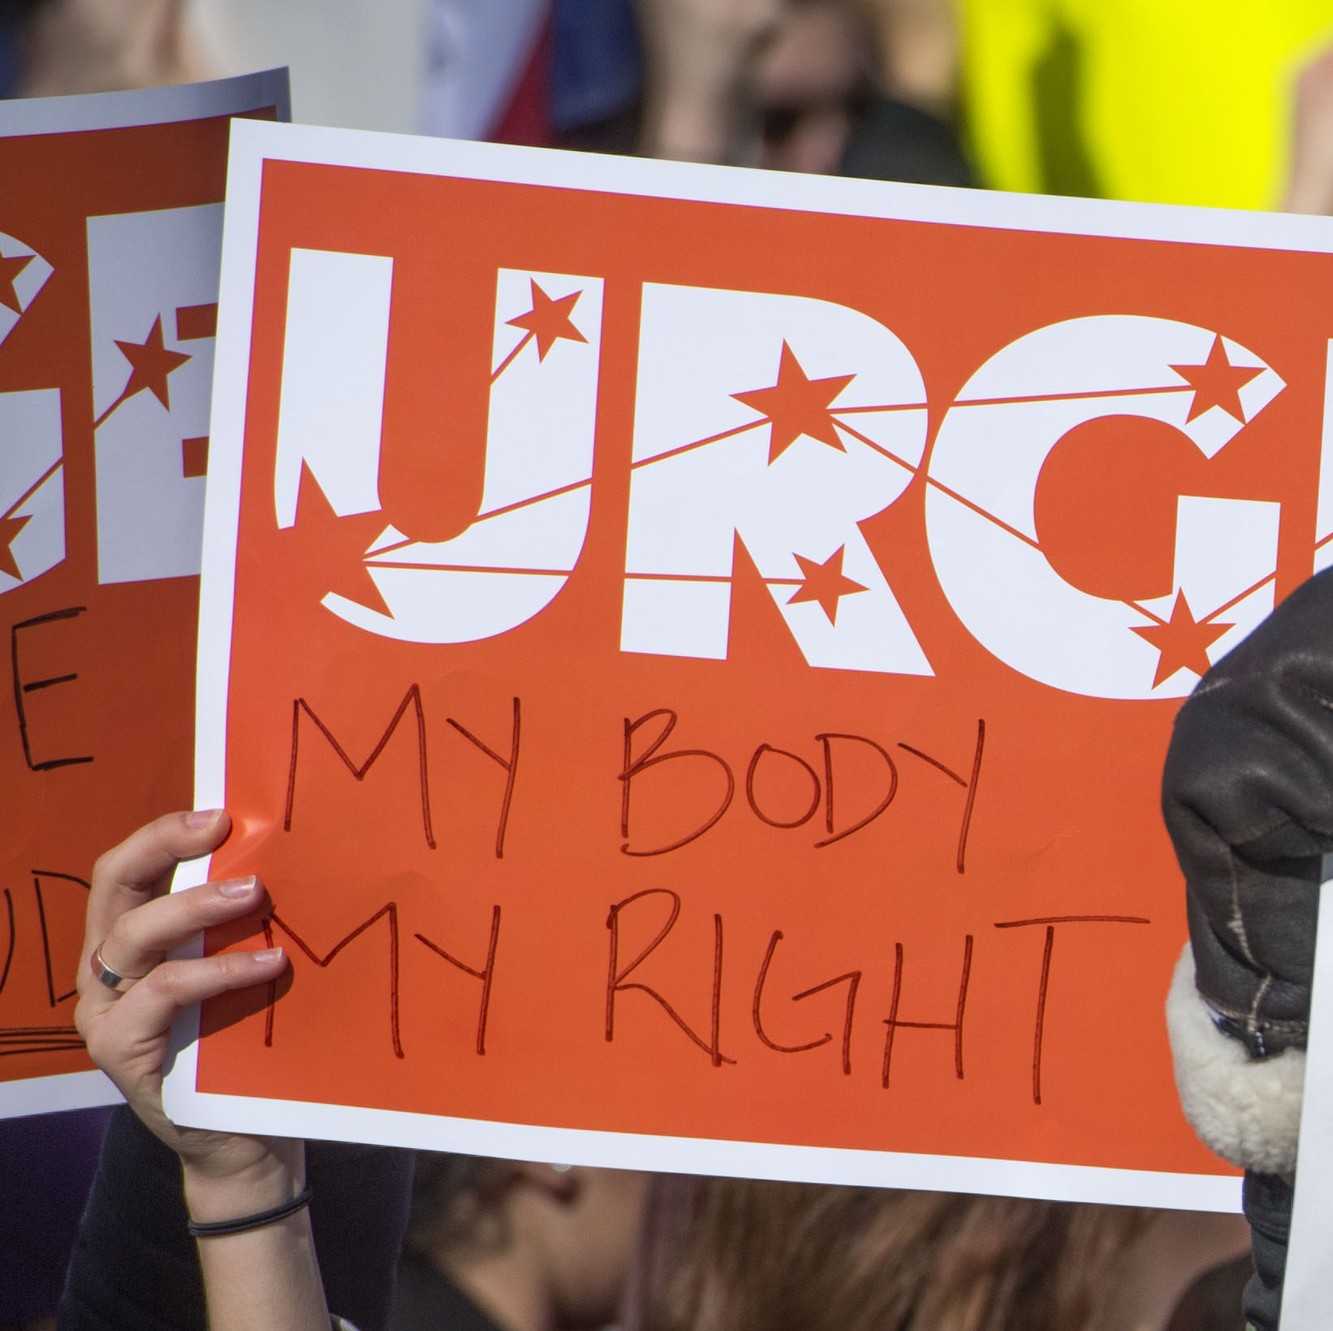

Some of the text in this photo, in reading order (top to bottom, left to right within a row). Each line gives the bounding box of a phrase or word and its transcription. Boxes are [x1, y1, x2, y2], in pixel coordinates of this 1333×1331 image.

[283, 683, 986, 875] MY BODY
[262, 888, 1151, 1106] MY RIGHT
